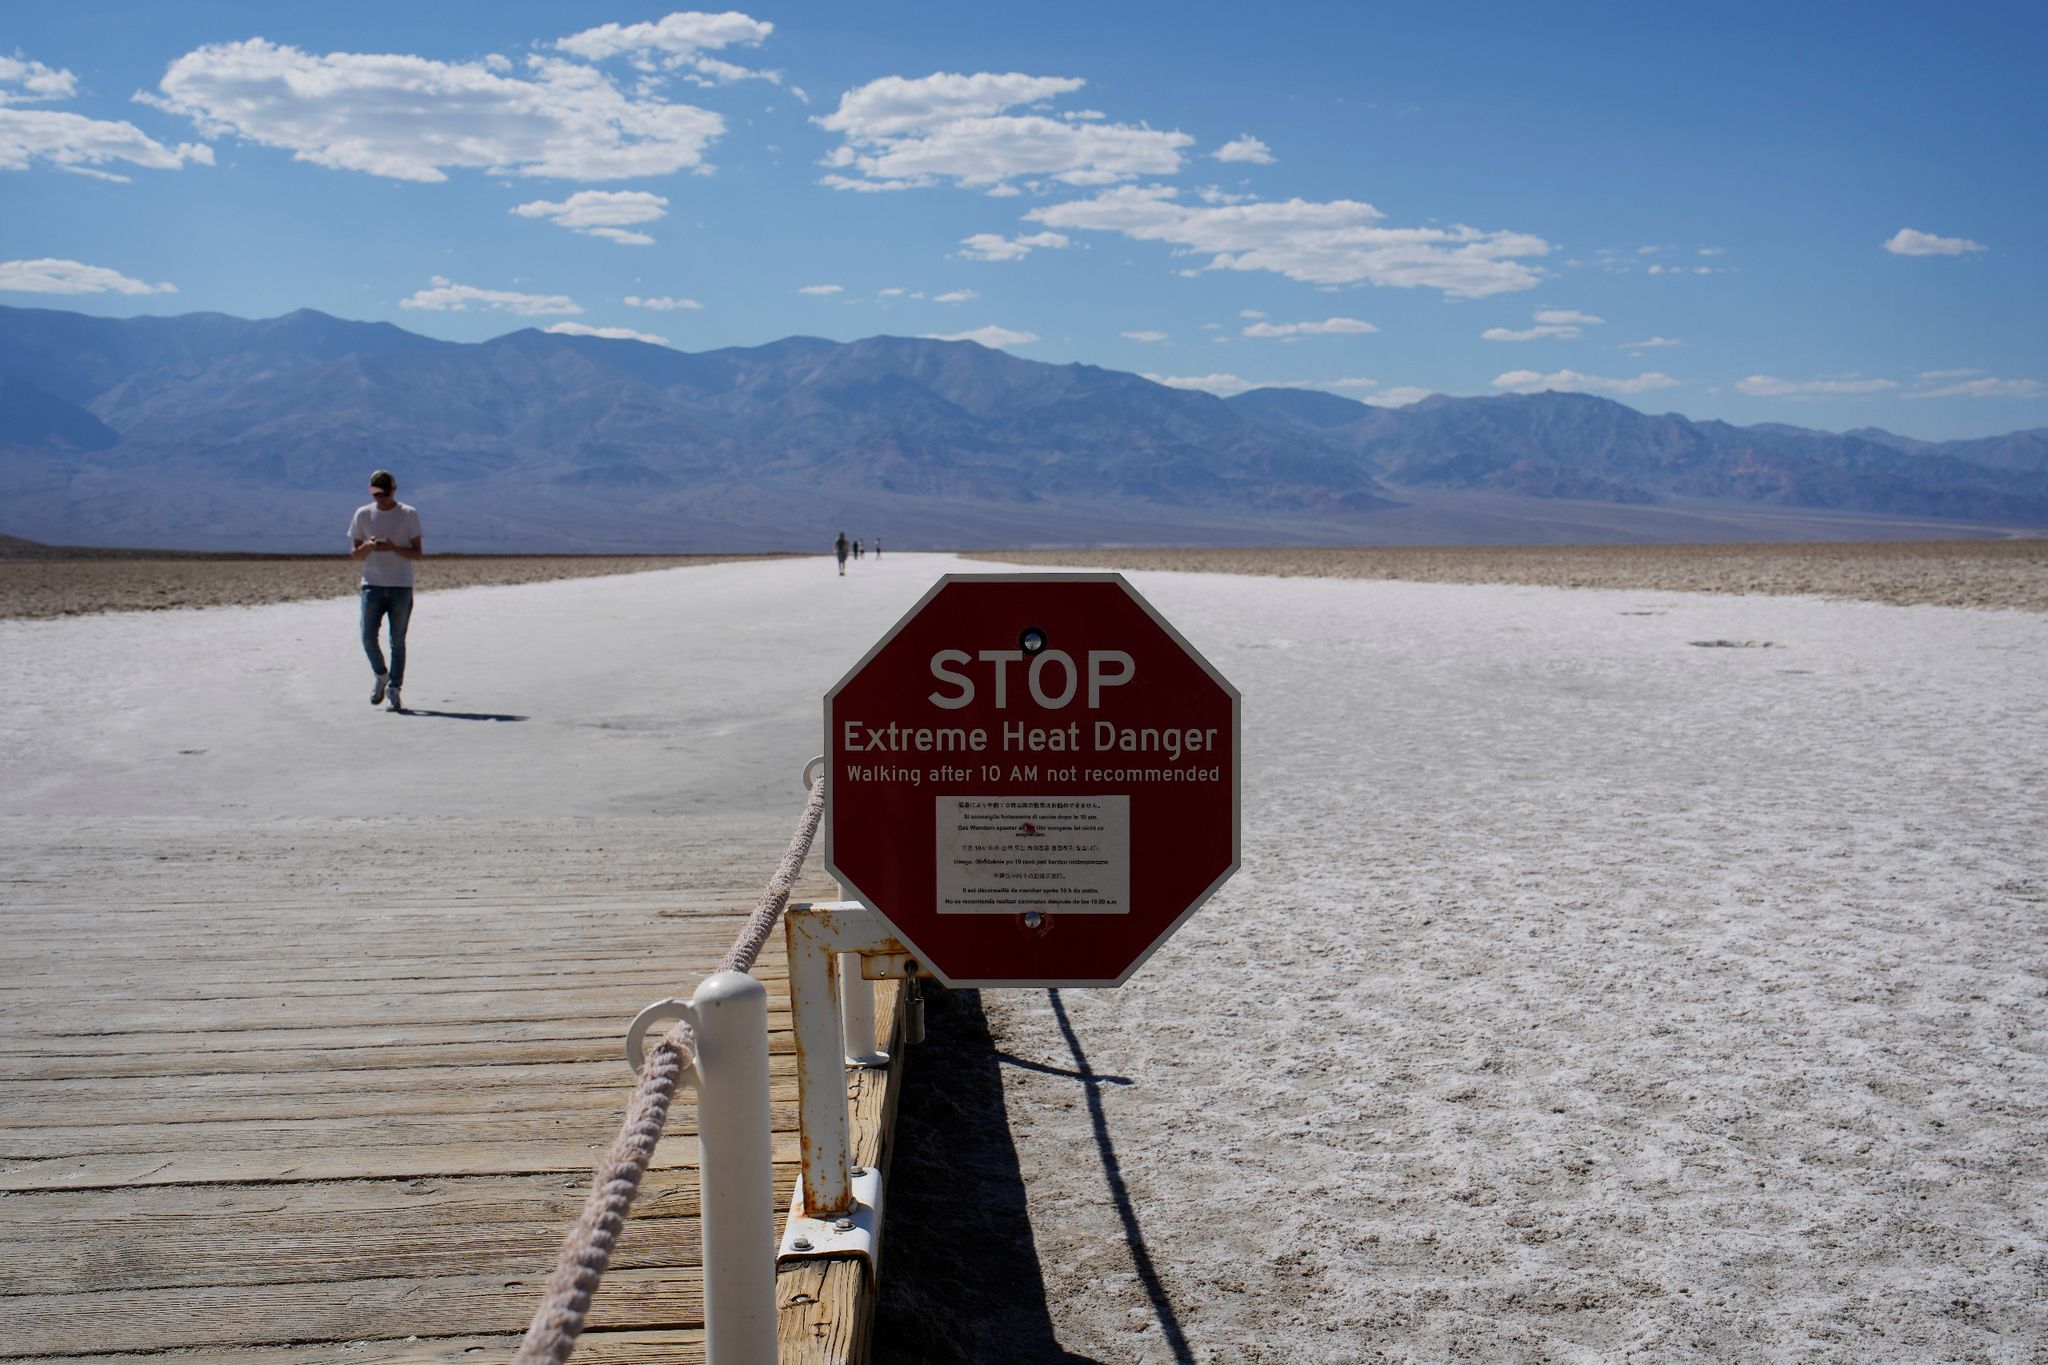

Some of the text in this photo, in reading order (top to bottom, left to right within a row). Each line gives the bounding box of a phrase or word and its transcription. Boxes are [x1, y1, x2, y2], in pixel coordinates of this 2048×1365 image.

[928, 649, 1136, 710] STOP
[844, 720, 1218, 762] Extreme Heat Danger
[847, 765, 1220, 786] Walking after 10 AM not recommended
